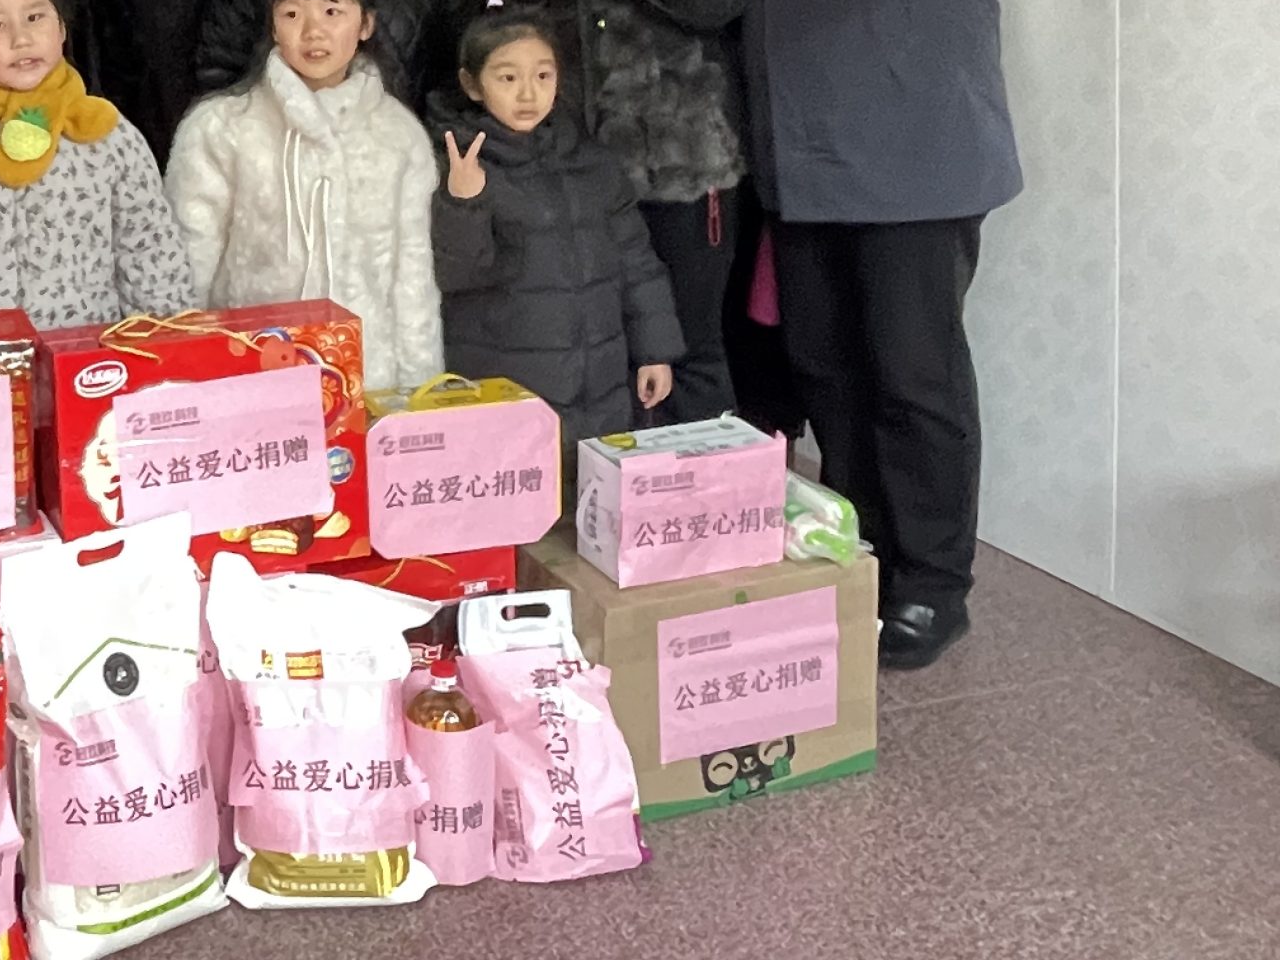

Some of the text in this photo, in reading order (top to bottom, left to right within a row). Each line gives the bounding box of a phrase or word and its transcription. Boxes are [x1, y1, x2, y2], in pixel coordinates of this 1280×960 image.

[136, 435, 309, 489] 公益爱心捐赠
[384, 467, 543, 509] 公益爱心捐赠
[674, 656, 823, 710] 公益爱心捐赠
